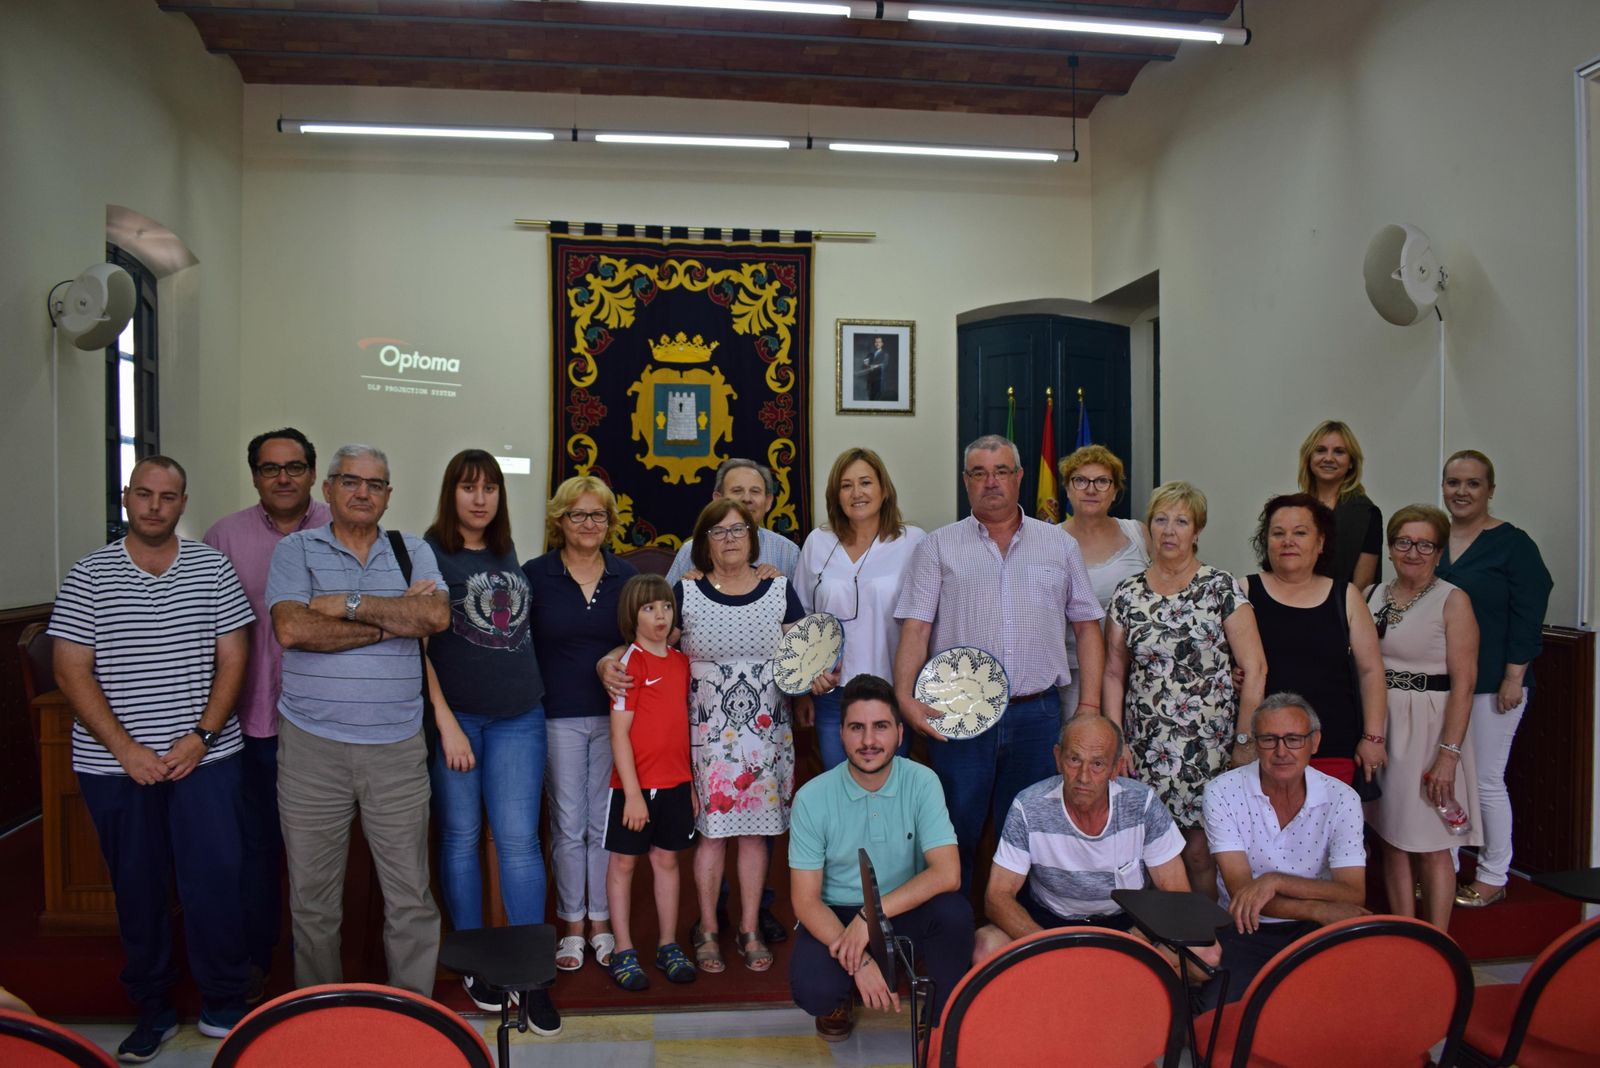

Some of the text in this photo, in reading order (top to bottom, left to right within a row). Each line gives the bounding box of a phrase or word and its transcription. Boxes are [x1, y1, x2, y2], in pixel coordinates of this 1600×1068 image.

[379, 345, 460, 374] Optoma
[367, 383, 457, 398] DLP PROJECTION SYSTEM
